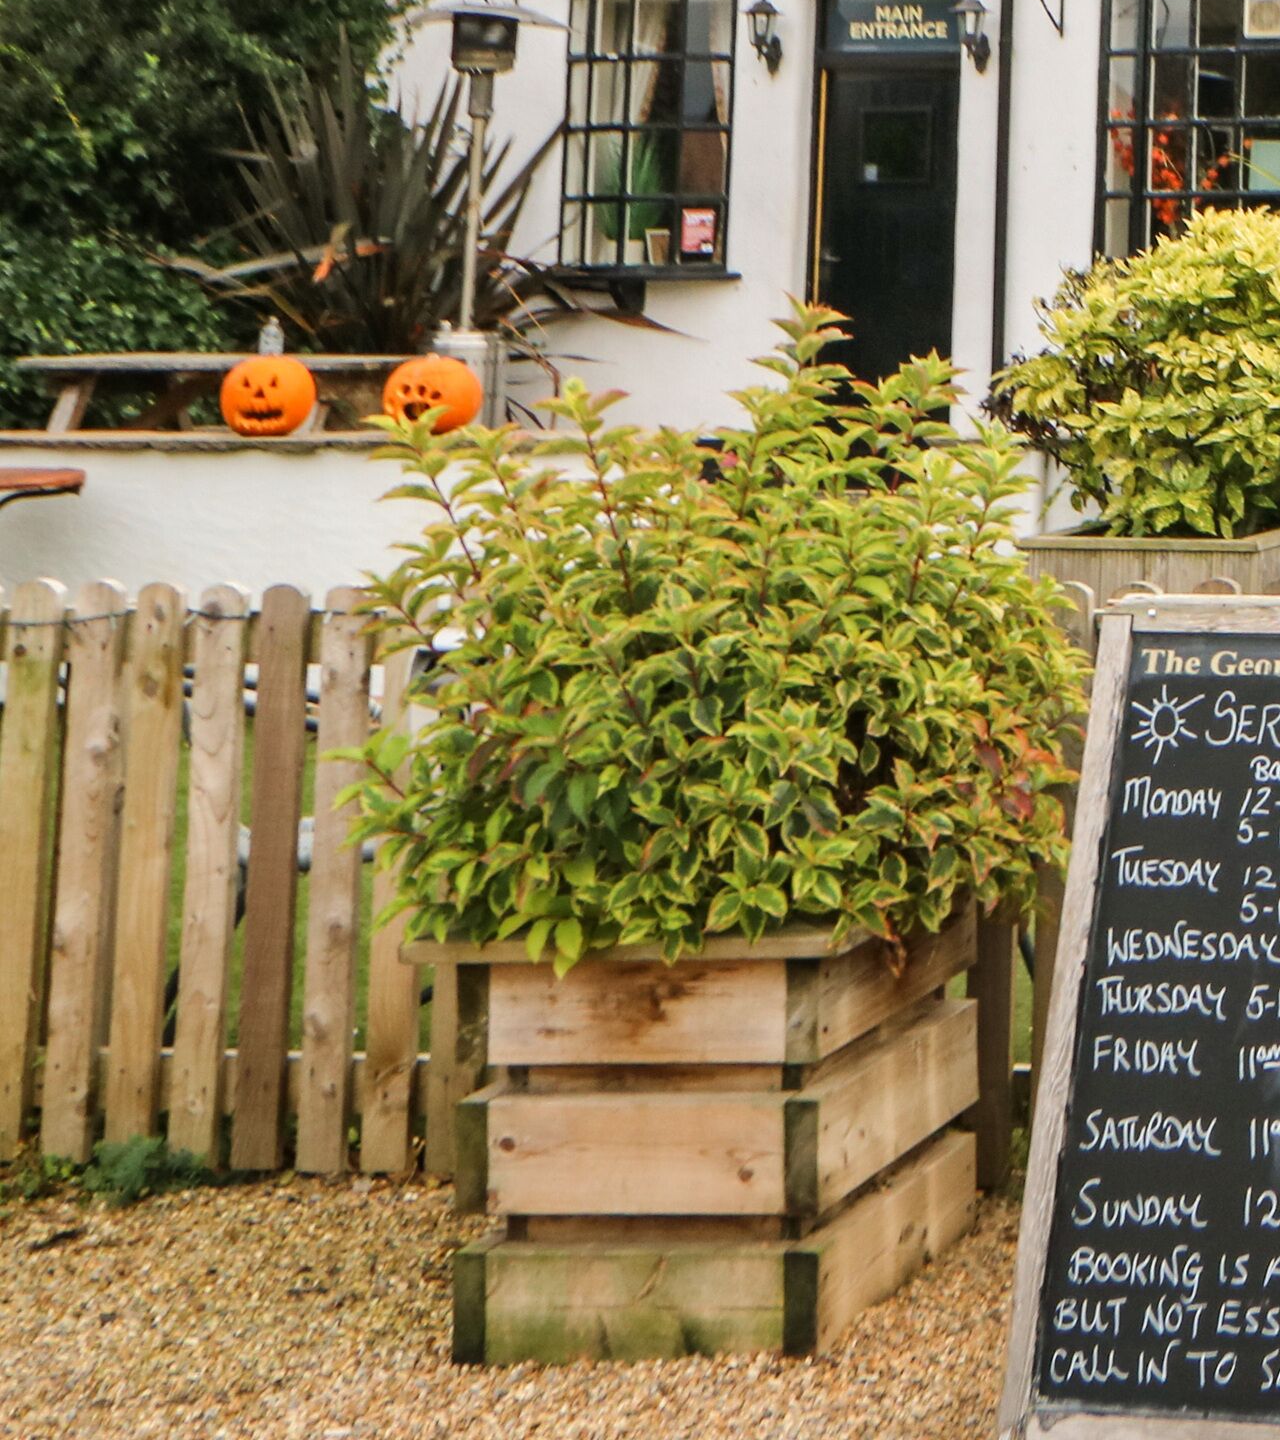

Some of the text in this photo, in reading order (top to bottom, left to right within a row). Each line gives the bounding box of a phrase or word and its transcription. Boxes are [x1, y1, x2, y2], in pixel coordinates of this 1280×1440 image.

[849, 21, 948, 39] ENTRANCE
[875, 4, 923, 22] MAIN
[1141, 648, 1201, 675] The
[1111, 845, 1221, 893] TUESDAY
[1096, 975, 1227, 1021] THURSDAY
[1093, 1034, 1201, 1077] FRIDAY
[1079, 1108, 1221, 1156] SATURDAY
[1071, 1177, 1208, 1228] SUNDAY
[1068, 1244, 1205, 1304] BOOKING
[1219, 1253, 1250, 1286] IS
[1053, 1297, 1127, 1336] BUT
[1141, 1295, 1206, 1339] NOT
[1050, 1344, 1129, 1383] CALL
[1138, 1339, 1180, 1384] IN
[1185, 1350, 1238, 1387] TO
